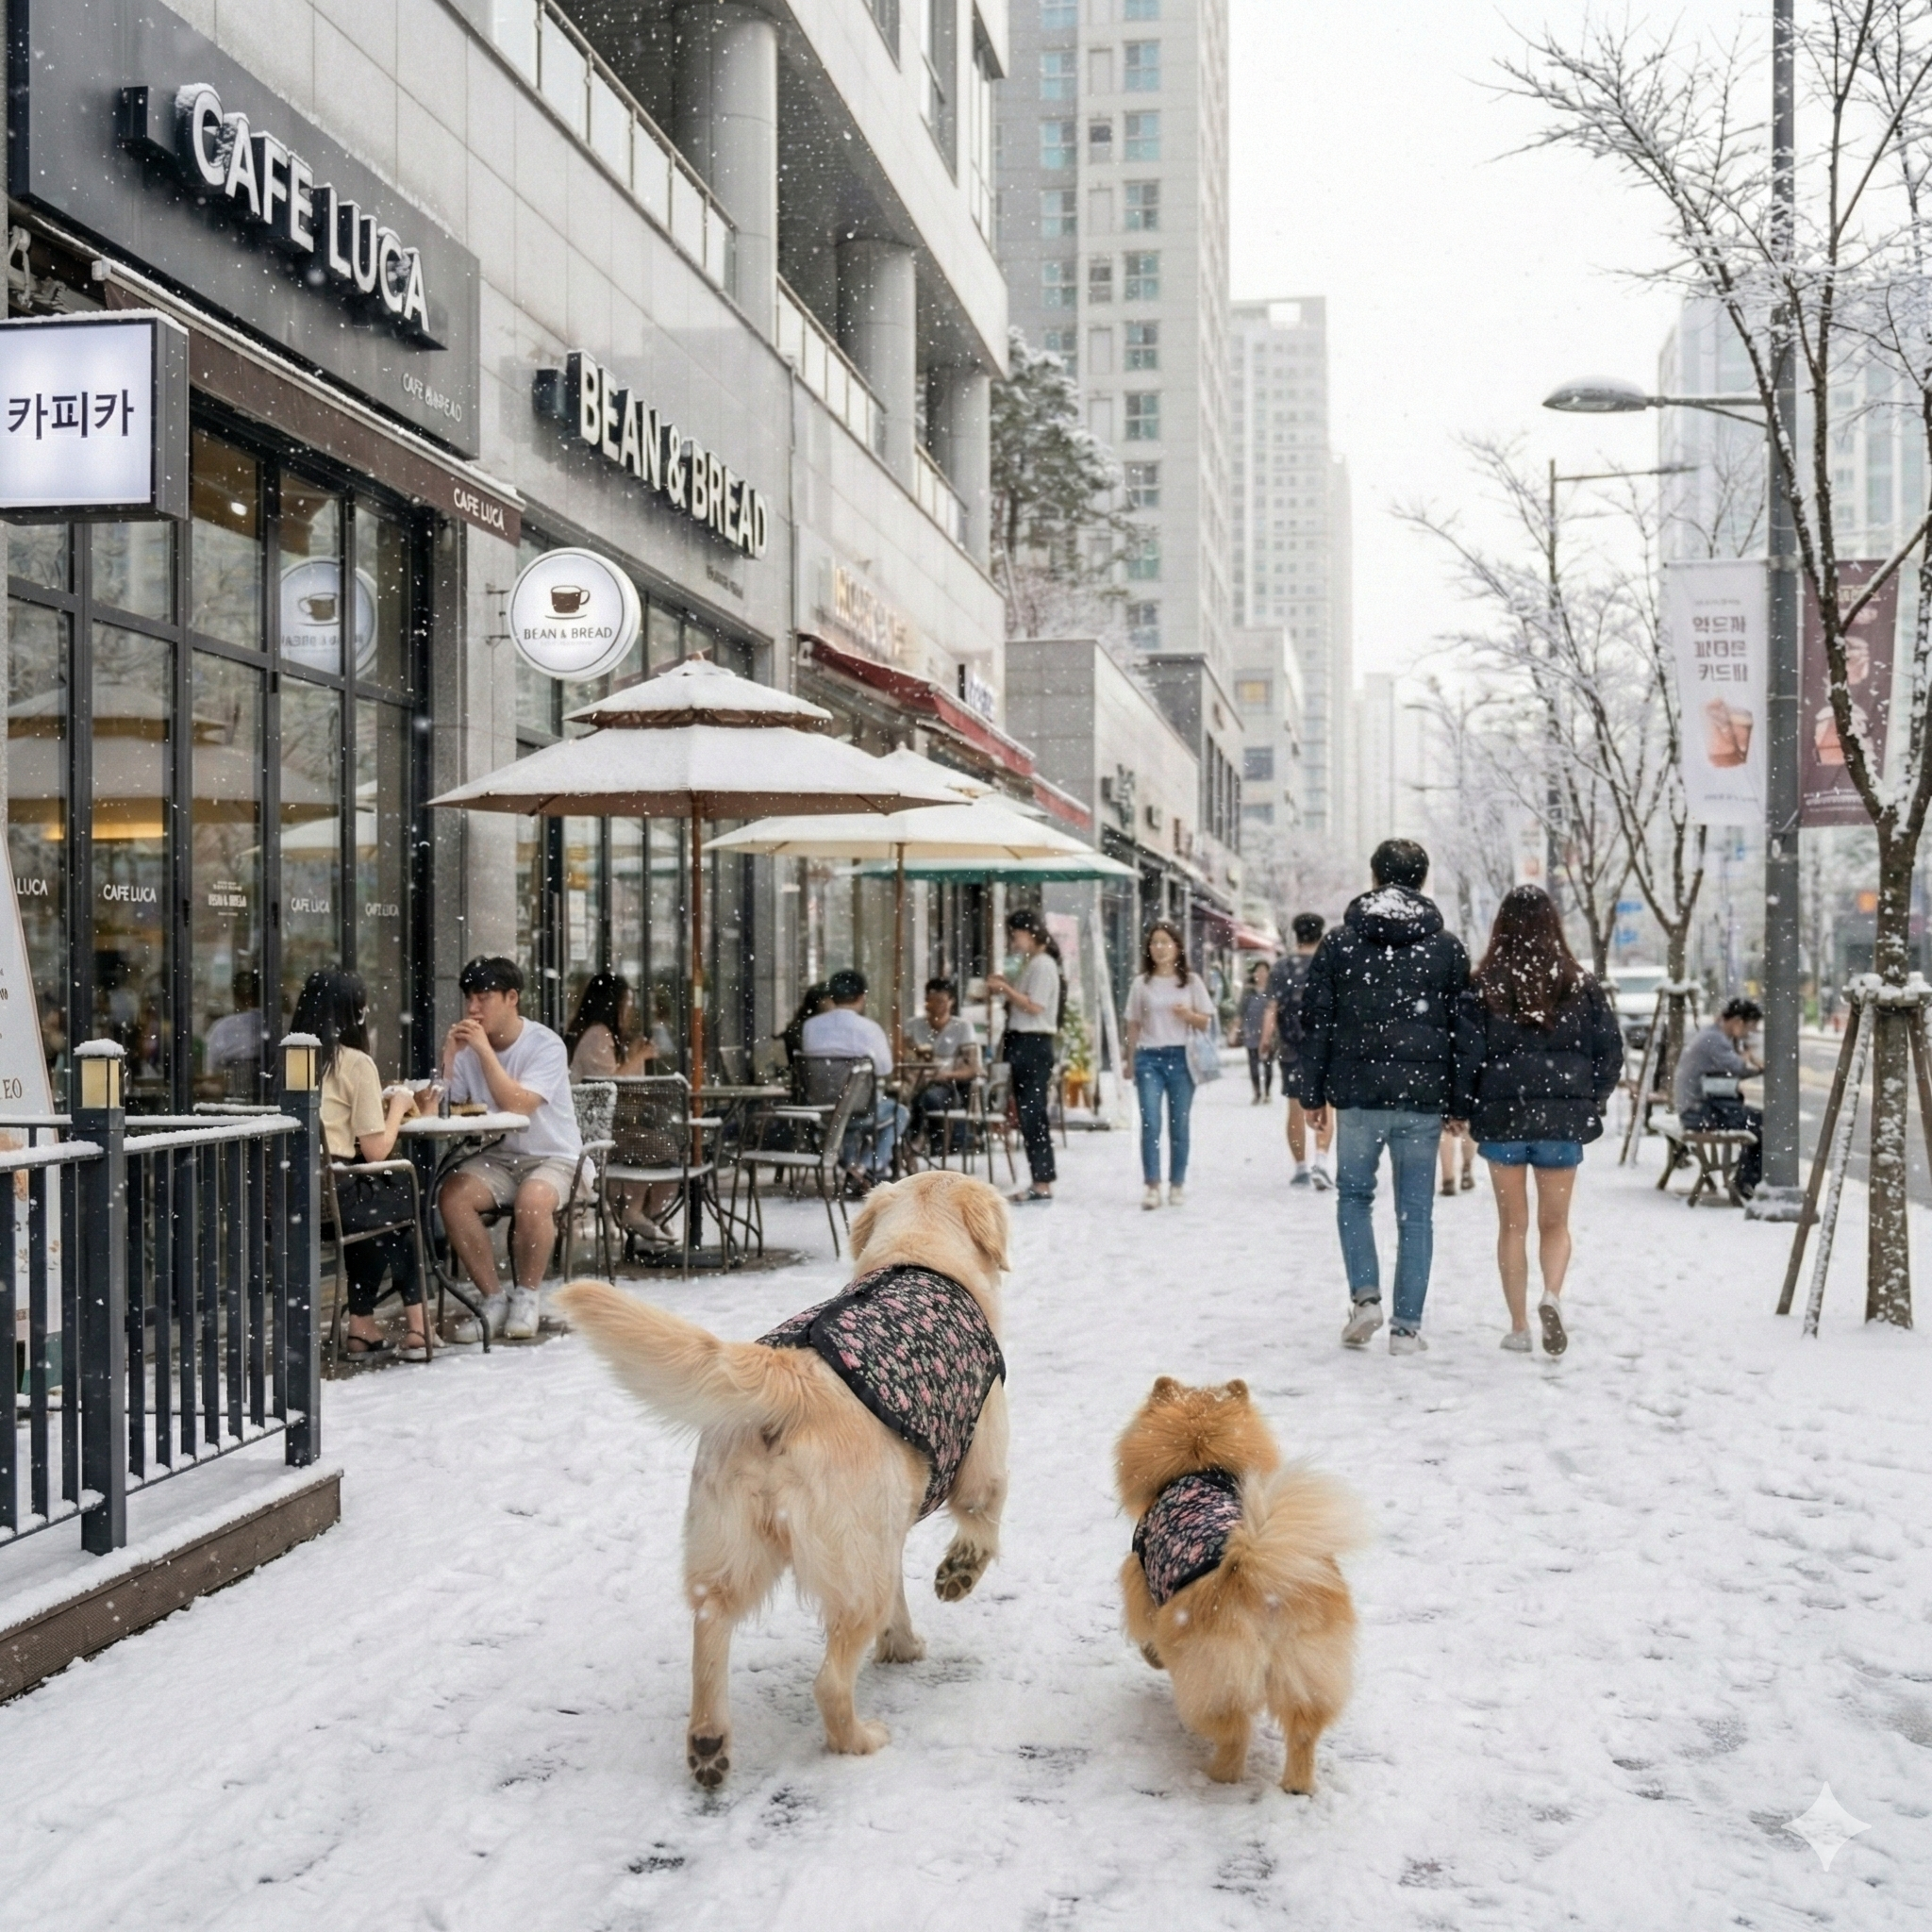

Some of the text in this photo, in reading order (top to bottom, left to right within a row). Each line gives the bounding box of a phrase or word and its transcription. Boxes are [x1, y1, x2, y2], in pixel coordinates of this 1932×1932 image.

[192, 88, 429, 332] CAFE LUCA
[8, 389, 135, 441] 카피카
[579, 351, 768, 559] BEAN & BREAD
[454, 487, 505, 531] CAFE LUCA
[524, 627, 613, 640] BEAN & BREAD
[16, 877, 48, 896] LUCA
[103, 884, 157, 903] CAFE LUCA
